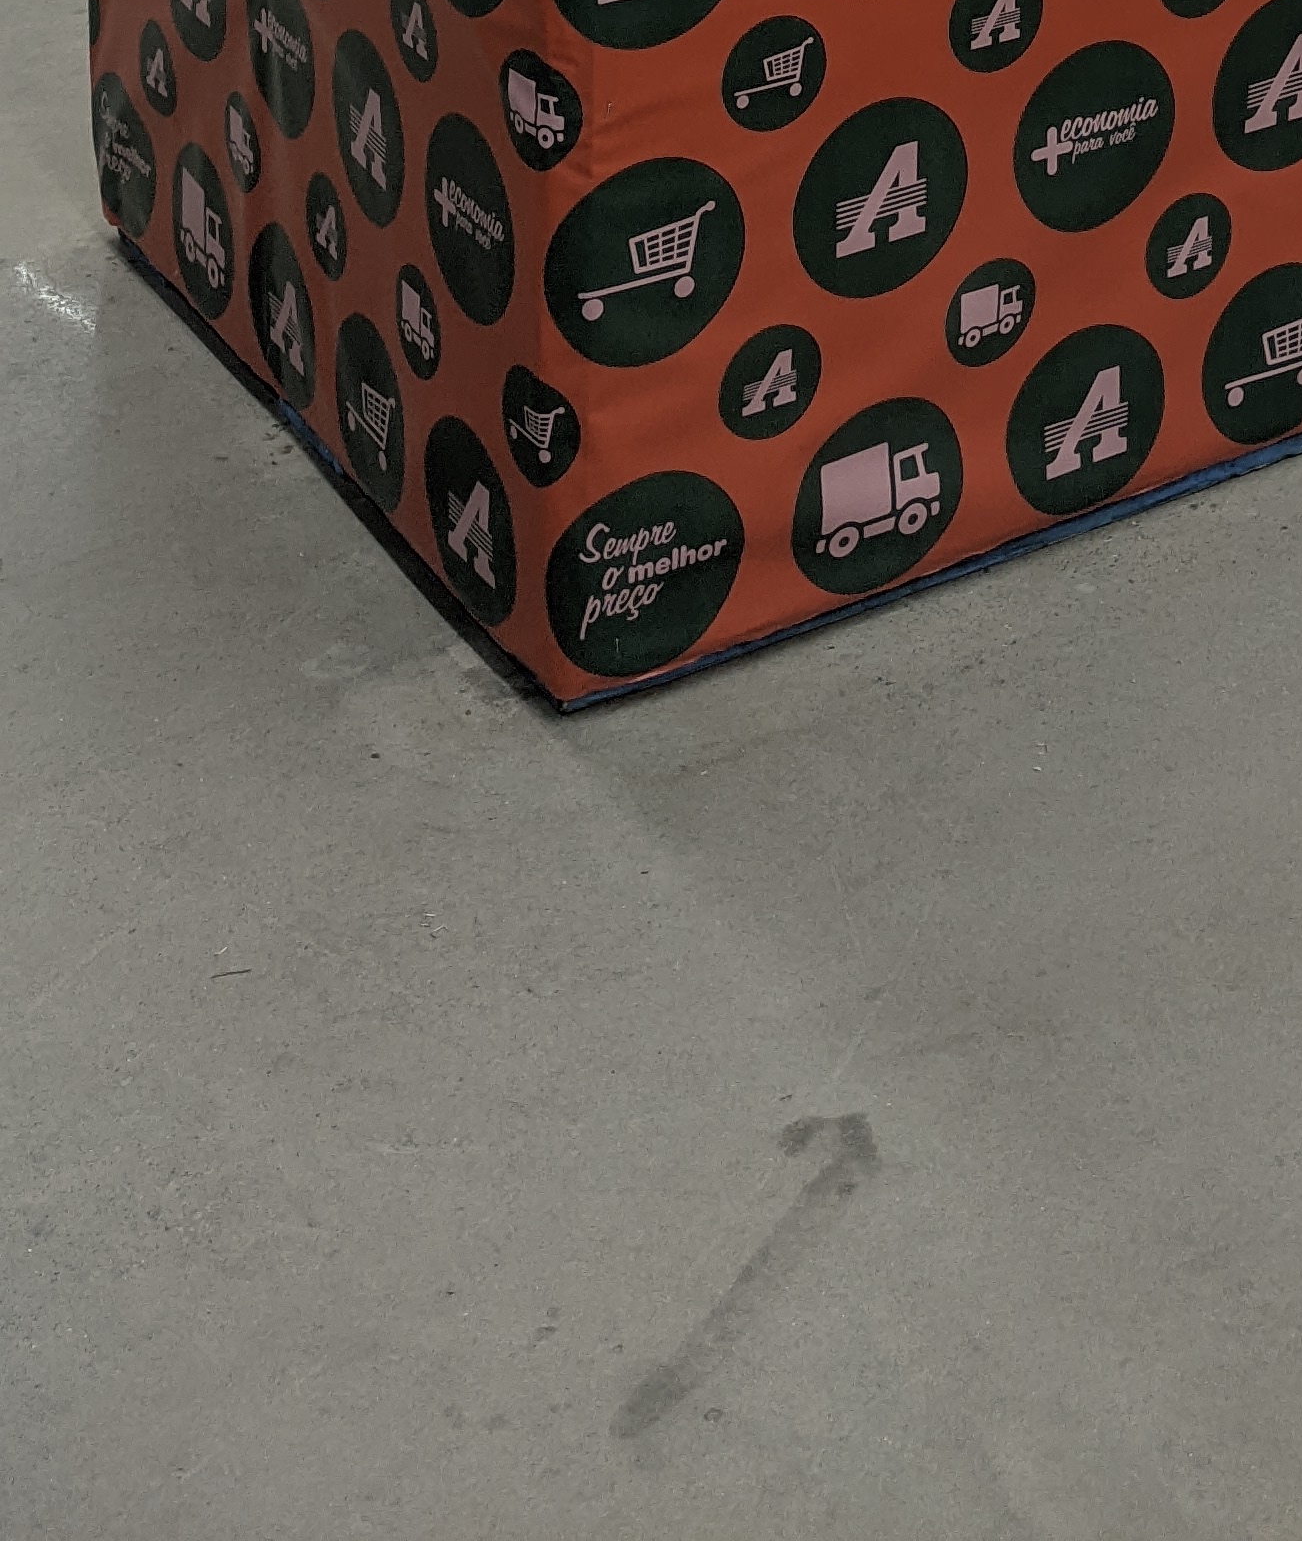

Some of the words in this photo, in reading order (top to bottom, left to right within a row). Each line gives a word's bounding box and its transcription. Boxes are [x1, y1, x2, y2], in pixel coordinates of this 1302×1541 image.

[1071, 134, 1104, 164] para
[1109, 120, 1136, 146] você
[579, 521, 676, 564] Sempre
[602, 566, 621, 590] o
[627, 537, 728, 584] melhor
[581, 580, 664, 640] preço
